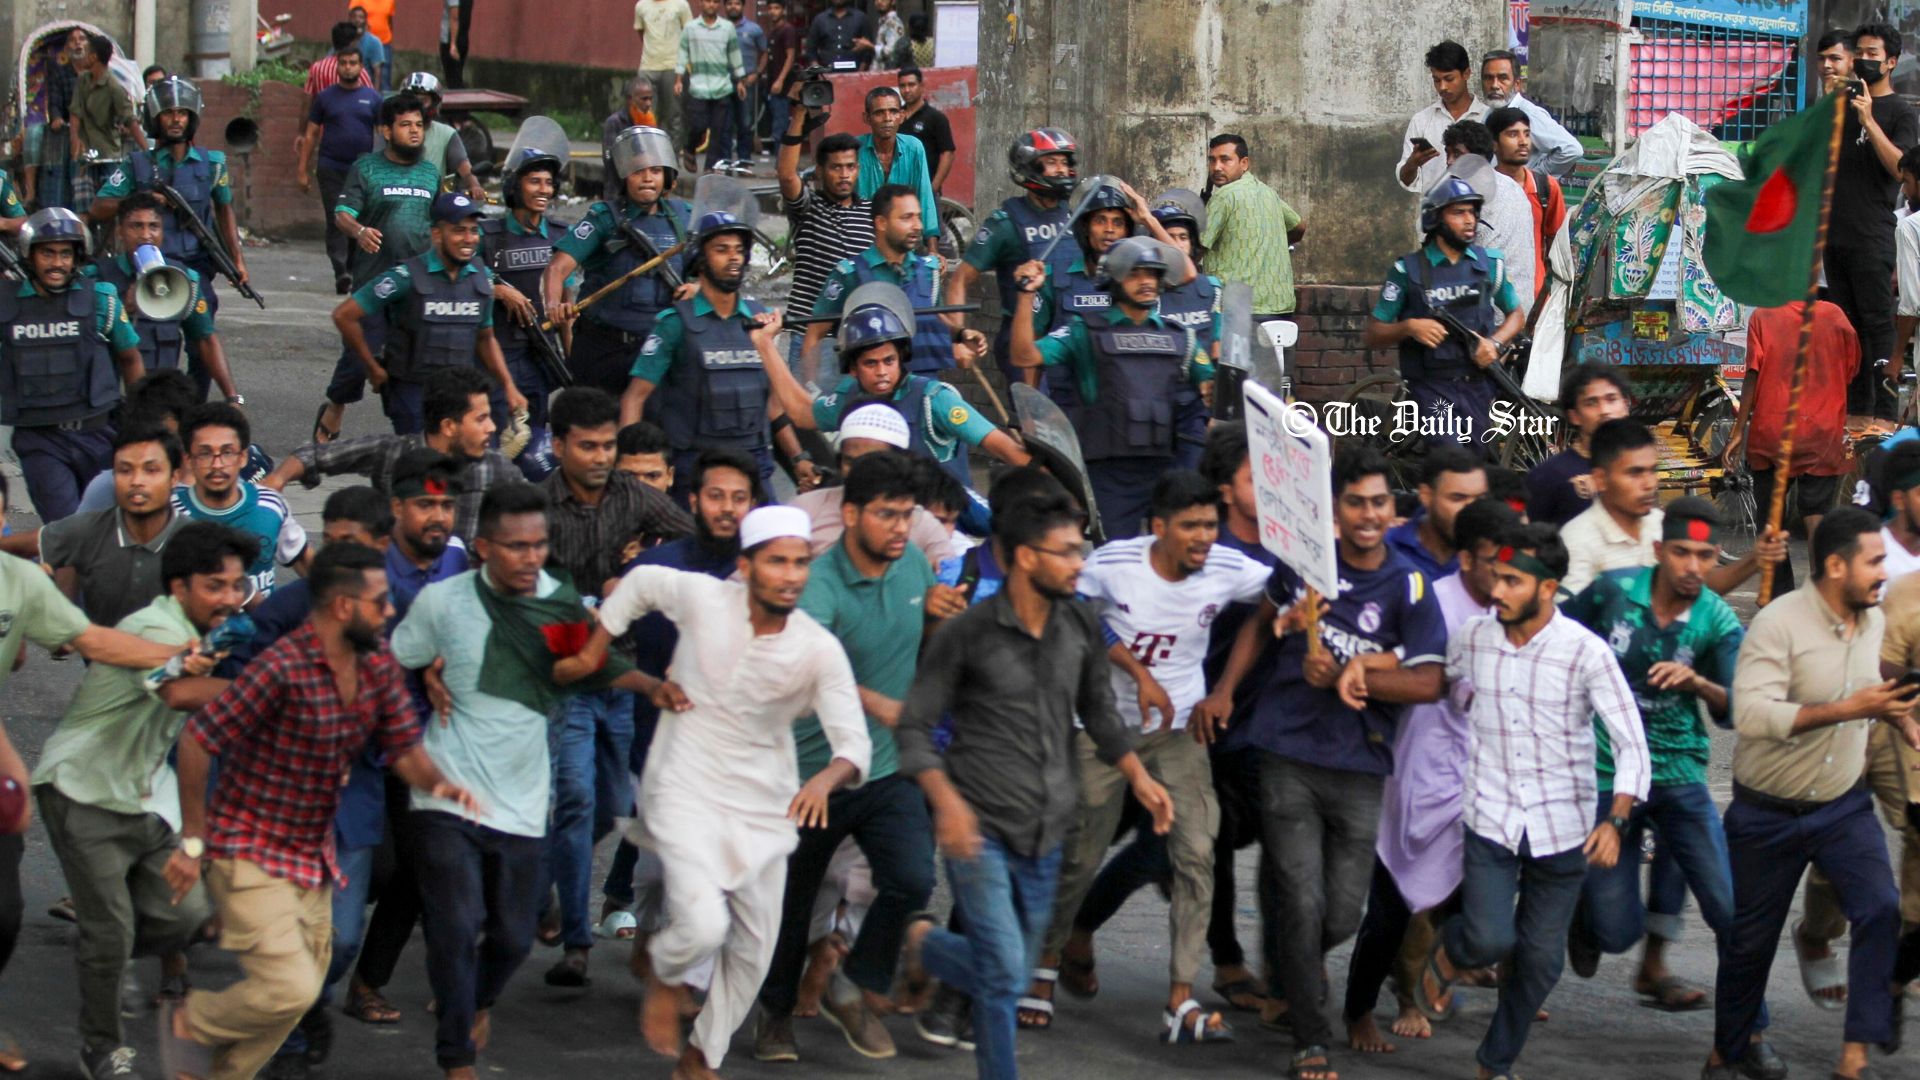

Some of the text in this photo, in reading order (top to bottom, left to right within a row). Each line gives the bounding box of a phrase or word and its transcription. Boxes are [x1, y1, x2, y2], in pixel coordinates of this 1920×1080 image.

[424, 301, 480, 316] POLICE
[12, 321, 80, 340] POLICE
[1118, 335, 1168, 349] POLICE
